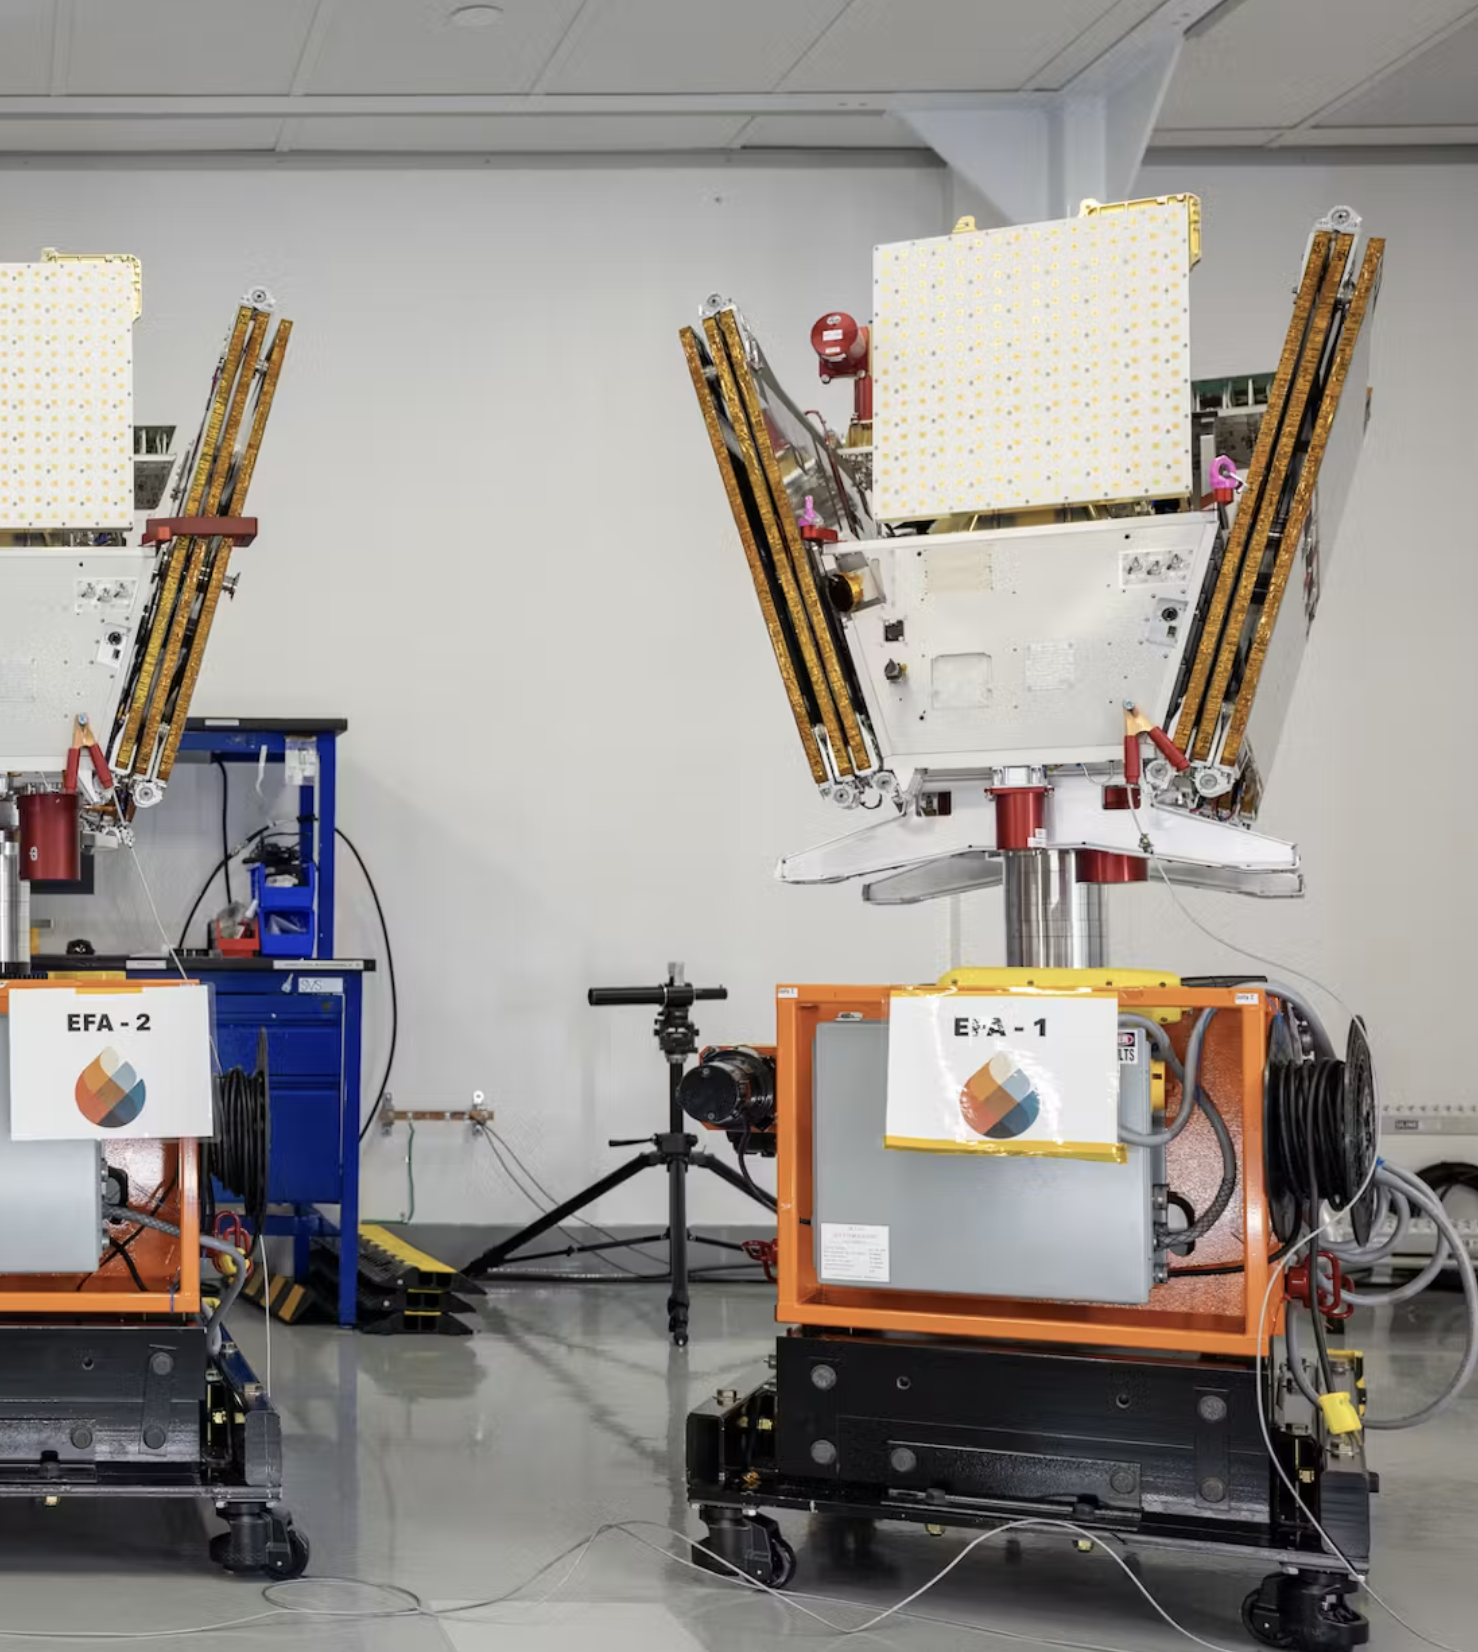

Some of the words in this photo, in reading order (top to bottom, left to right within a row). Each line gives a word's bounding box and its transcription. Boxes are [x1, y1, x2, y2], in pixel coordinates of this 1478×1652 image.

[300, 979, 322, 991] SVS
[67, 1013, 114, 1032] EFA
[136, 1013, 151, 1031] 2
[1033, 1018, 1046, 1036] 1
[1118, 1048, 1135, 1061] LTS
